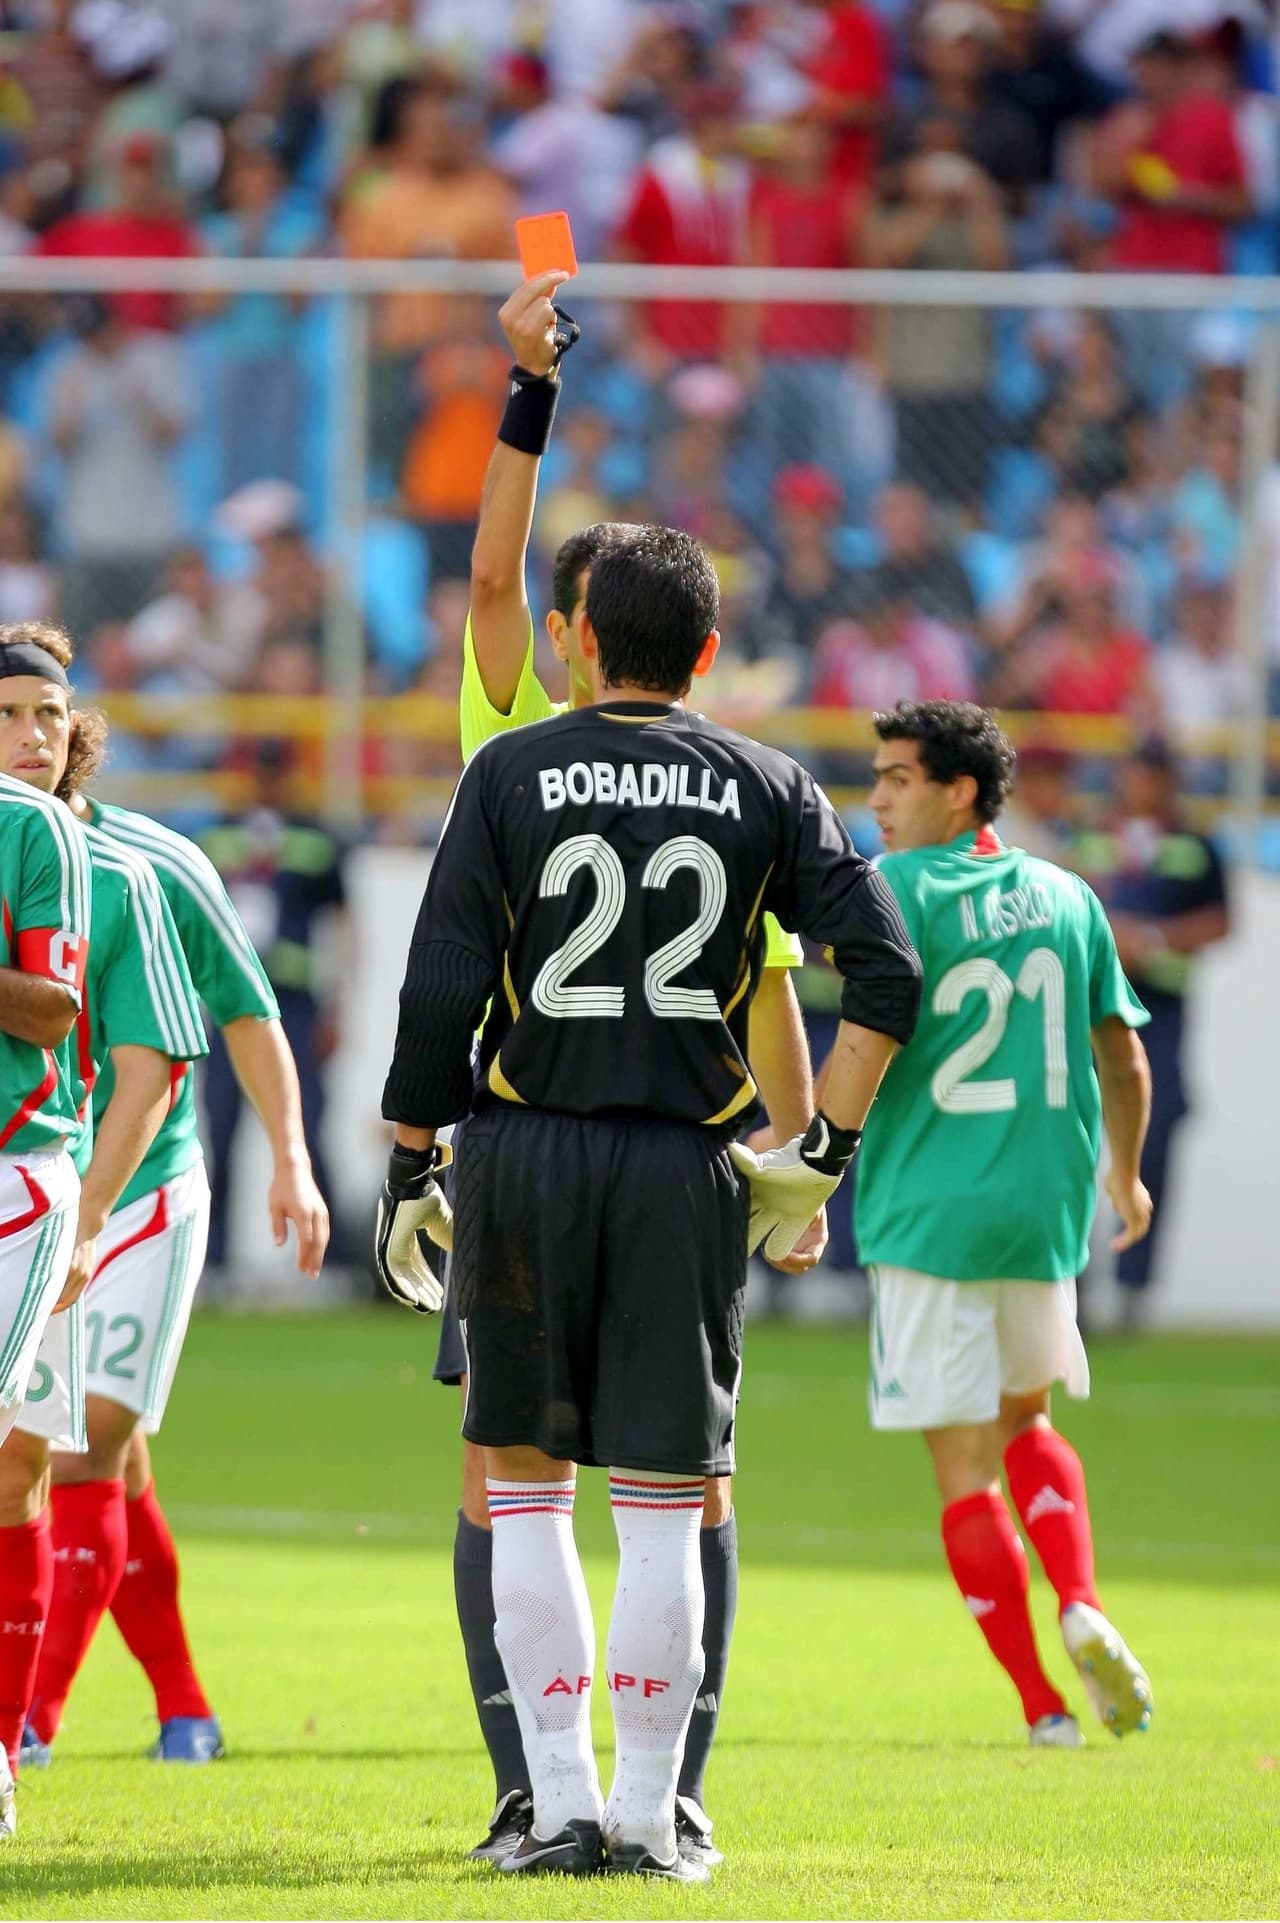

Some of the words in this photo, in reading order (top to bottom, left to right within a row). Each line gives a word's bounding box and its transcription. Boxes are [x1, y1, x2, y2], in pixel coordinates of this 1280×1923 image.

[538, 761, 742, 821] BOBADILLA
[49, 930, 80, 984] C
[532, 833, 727, 1020] 22
[931, 947, 1068, 1114] 21
[85, 1309, 145, 1380] 12
